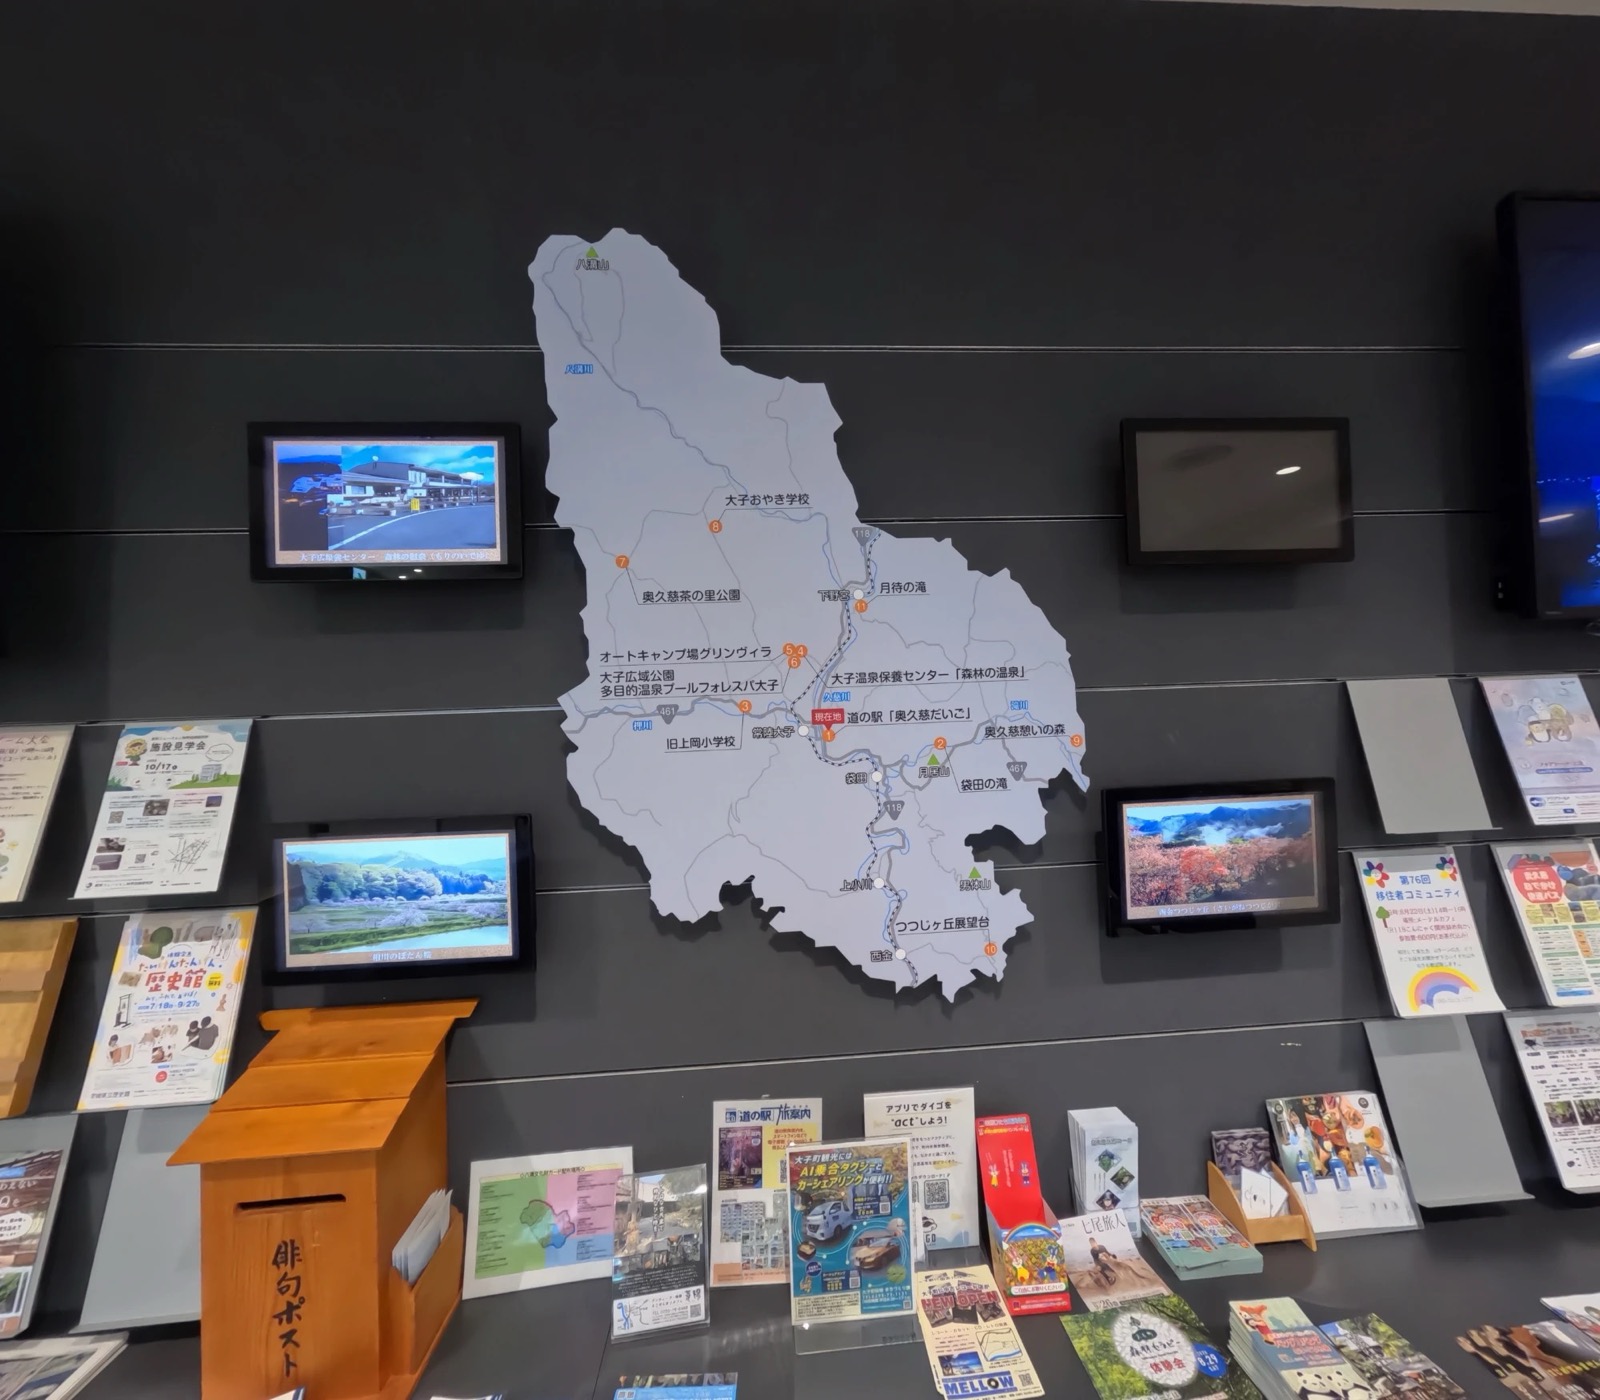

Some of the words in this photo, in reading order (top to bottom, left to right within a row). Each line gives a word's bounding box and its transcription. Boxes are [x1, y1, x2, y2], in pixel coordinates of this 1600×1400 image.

[725, 493, 811, 507] 大子おやき学校
[711, 521, 721, 532] 8
[855, 530, 871, 538] 118
[618, 557, 627, 567] 7
[879, 581, 927, 594] 月待の滝
[642, 589, 741, 603] 奥久慈茶の里公園
[818, 590, 850, 601] 下野宮
[857, 601, 866, 611] 11
[600, 647, 772, 663] オートキャンプ場グリンヴィラ
[785, 645, 793, 655] 5
[797, 646, 805, 656] 4
[790, 658, 798, 668] 6
[600, 670, 675, 684] 大子広域公園
[831, 665, 1025, 685] 大子温泉保養センター「森林の温泉」
[600, 680, 779, 697] 多目的温泉プールフォレスパ大子
[823, 692, 851, 702] 久慈川
[659, 706, 676, 716] 461
[741, 701, 749, 711] 3
[814, 711, 842, 722] 現在地
[847, 707, 971, 723] 道の駅「奥久慈だいご」
[984, 724, 1066, 738] 奥久慈憩いの森
[150, 741, 206, 752] 施設見学会
[666, 736, 736, 750] 旧上岡小学校
[936, 739, 944, 749] 2
[1072, 736, 1080, 746] 9
[145, 761, 172, 771] 10/17
[1009, 764, 1025, 773] 461
[845, 773, 868, 784] 袋田
[960, 777, 1008, 791] 袋田の滝
[886, 803, 902, 813] 118
[840, 879, 873, 891] 上小川
[959, 879, 992, 891] 男体山
[1399, 874, 1431, 885] 第76回
[1376, 888, 1460, 902] 移住者コミュニティ
[895, 915, 990, 933] つつじヶ丘展望台
[985, 944, 995, 954] 10
[870, 951, 893, 962] 西金
[145, 968, 207, 993] 歴史館
[886, 1101, 952, 1114] アプリでダイゴを
[794, 1152, 852, 1165] 大子町観光には
[800, 1162, 883, 1178] AI乗合タクシーと
[1081, 1214, 1126, 1235] 七尾旅人
[921, 1295, 955, 1310] NEW
[957, 1290, 1001, 1308] OPEN
[271, 1238, 306, 1378] 俳句ポスト
[1149, 1357, 1186, 1374] 体験会
[1197, 1353, 1218, 1367] 8.29
[944, 1375, 1014, 1396] MELLOW
